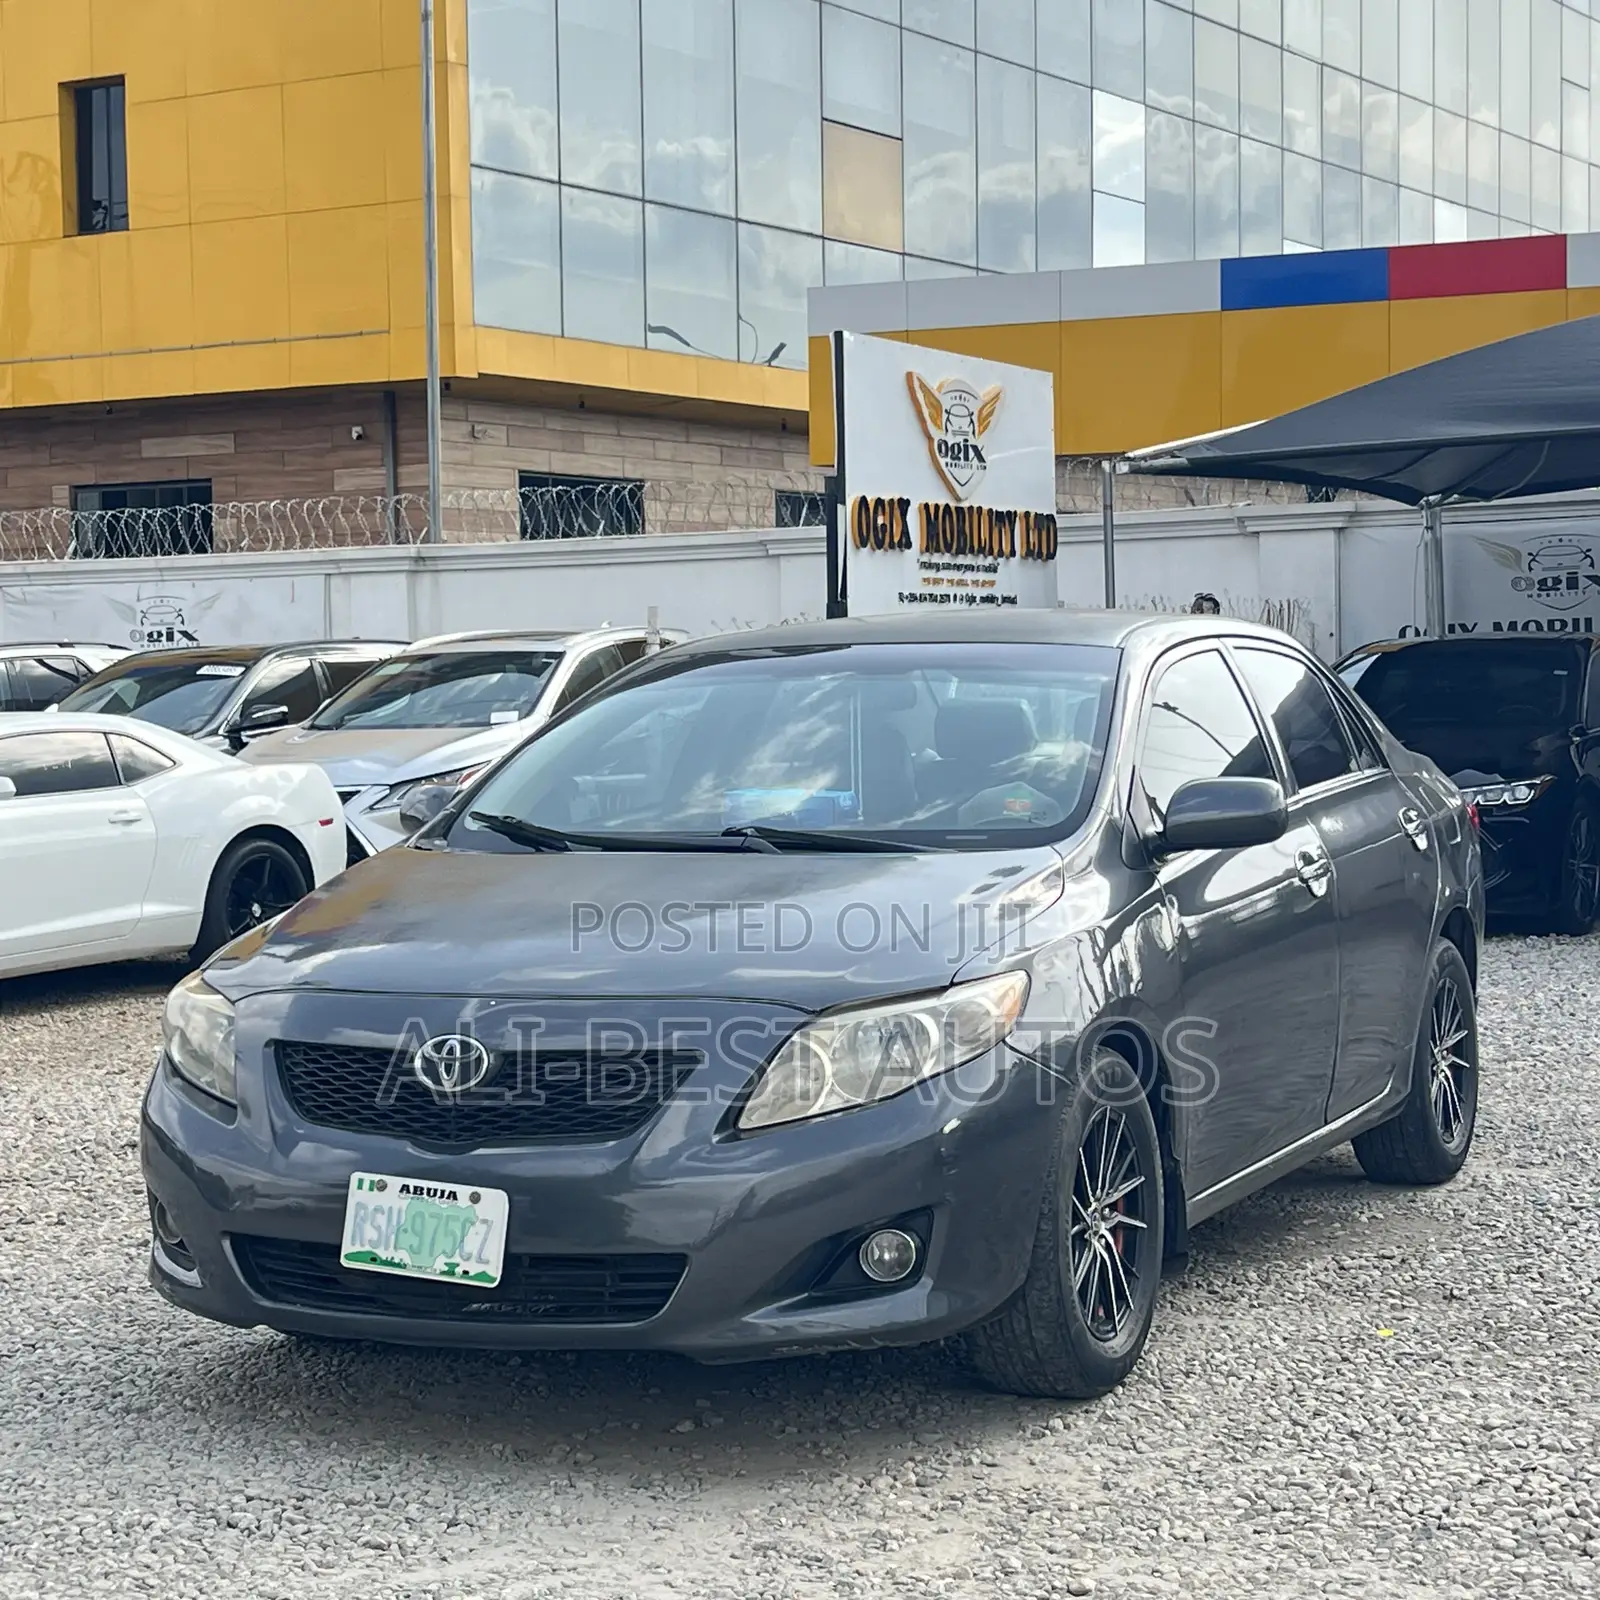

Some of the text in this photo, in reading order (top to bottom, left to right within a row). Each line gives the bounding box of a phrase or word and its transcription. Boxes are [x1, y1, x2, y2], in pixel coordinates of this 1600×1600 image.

[851, 495, 1058, 561] OGIX MOBILITY LTD
[399, 1183, 459, 1201] ABUJA
